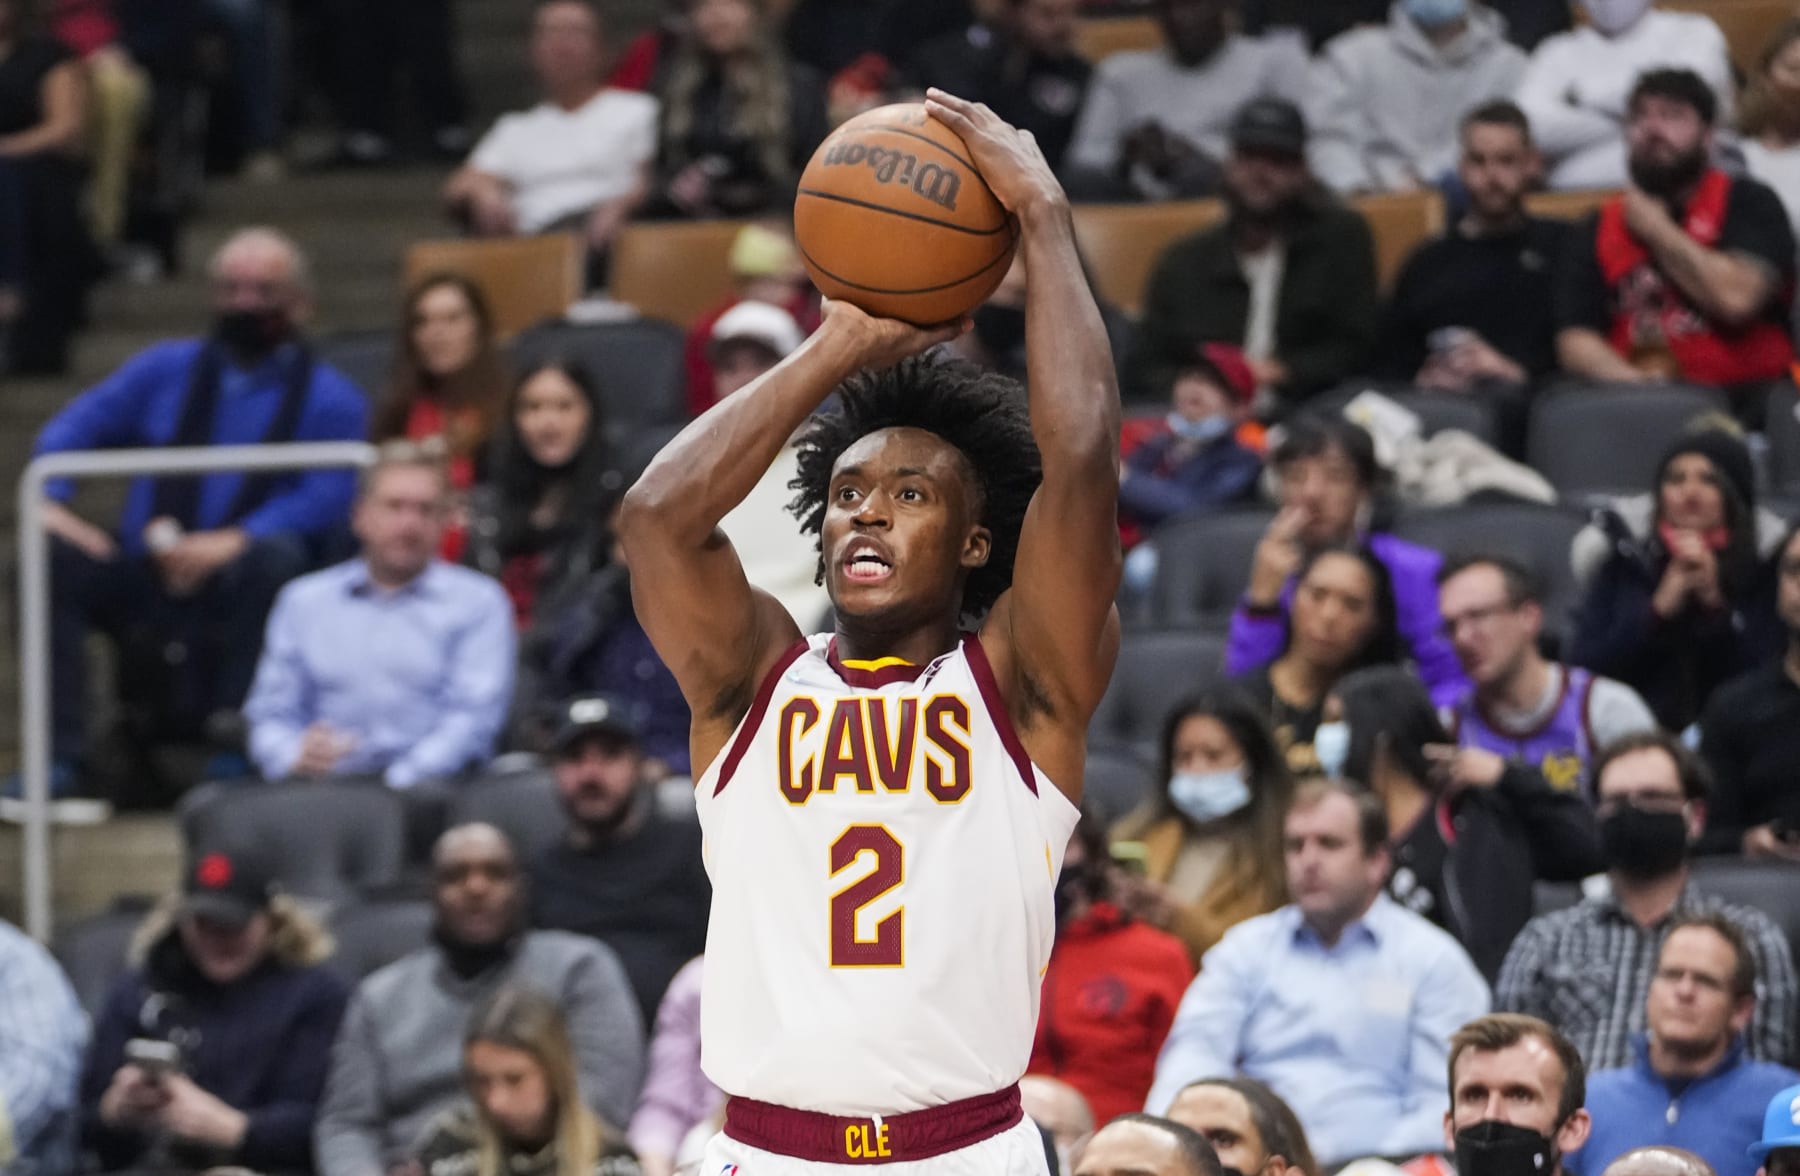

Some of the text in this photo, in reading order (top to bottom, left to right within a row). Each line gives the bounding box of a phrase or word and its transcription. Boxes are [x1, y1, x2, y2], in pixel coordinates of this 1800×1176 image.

[822, 142, 962, 212] Wilson
[778, 694, 973, 807] CAVS
[828, 822, 905, 968] 2
[845, 1123, 892, 1159] CLE
